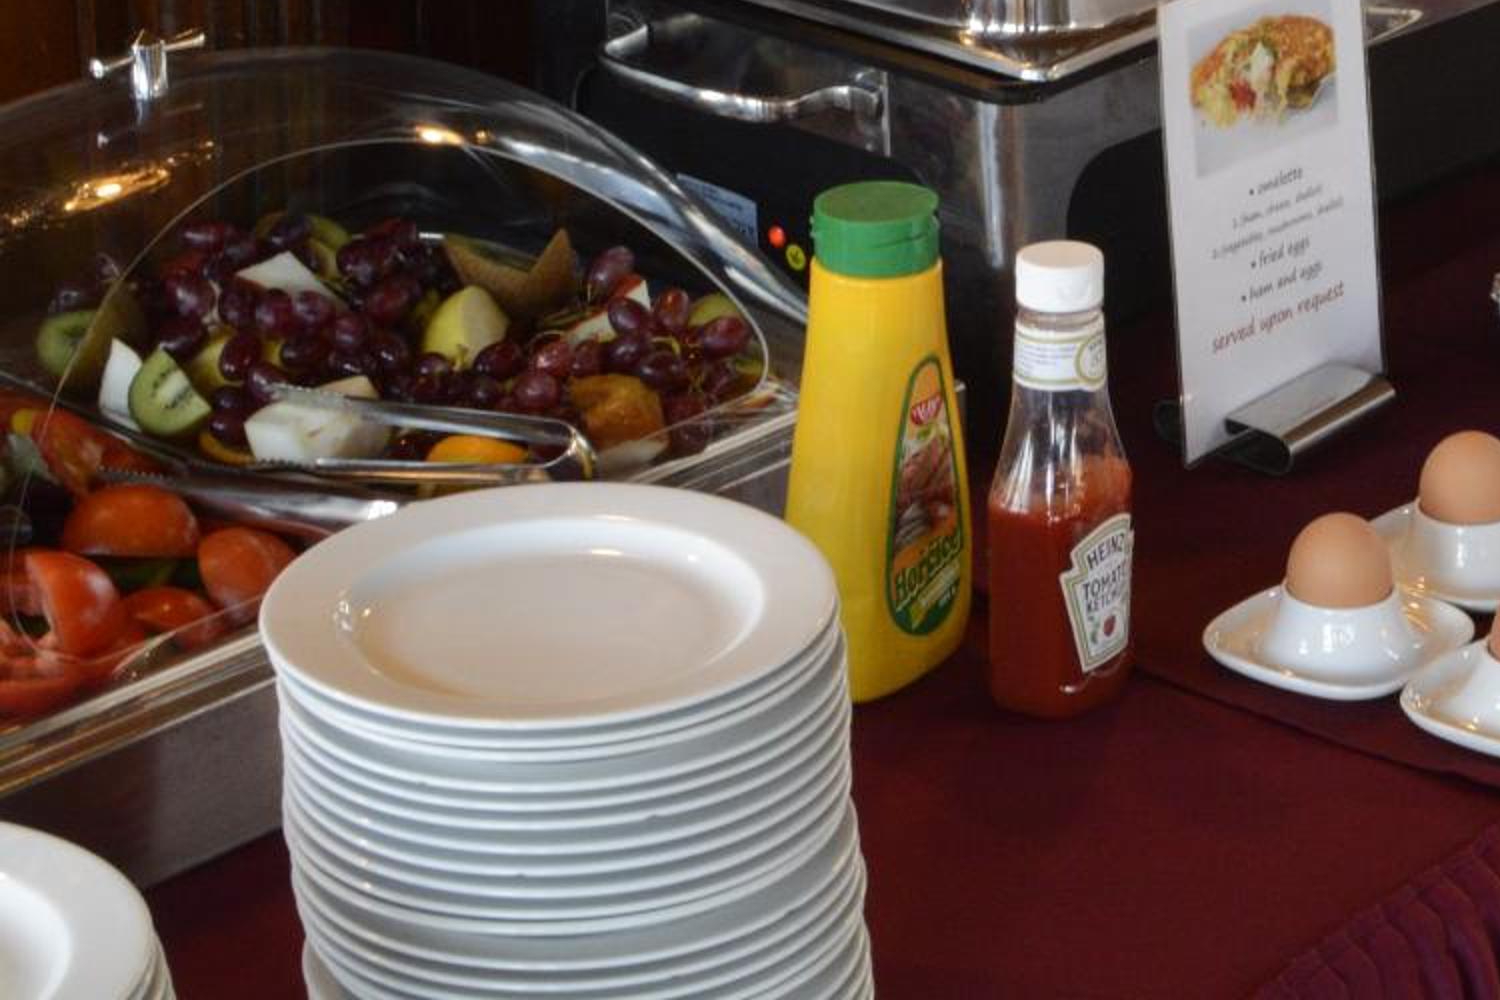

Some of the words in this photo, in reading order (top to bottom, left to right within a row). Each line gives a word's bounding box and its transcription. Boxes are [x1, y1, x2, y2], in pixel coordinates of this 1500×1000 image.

[1259, 239, 1284, 268] fried
[1248, 282, 1273, 302] ham
[1277, 265, 1297, 289] and
[1212, 315, 1255, 354] served
[1260, 307, 1293, 334] upon
[1297, 279, 1344, 313] request
[1087, 532, 1126, 571] HEINZ
